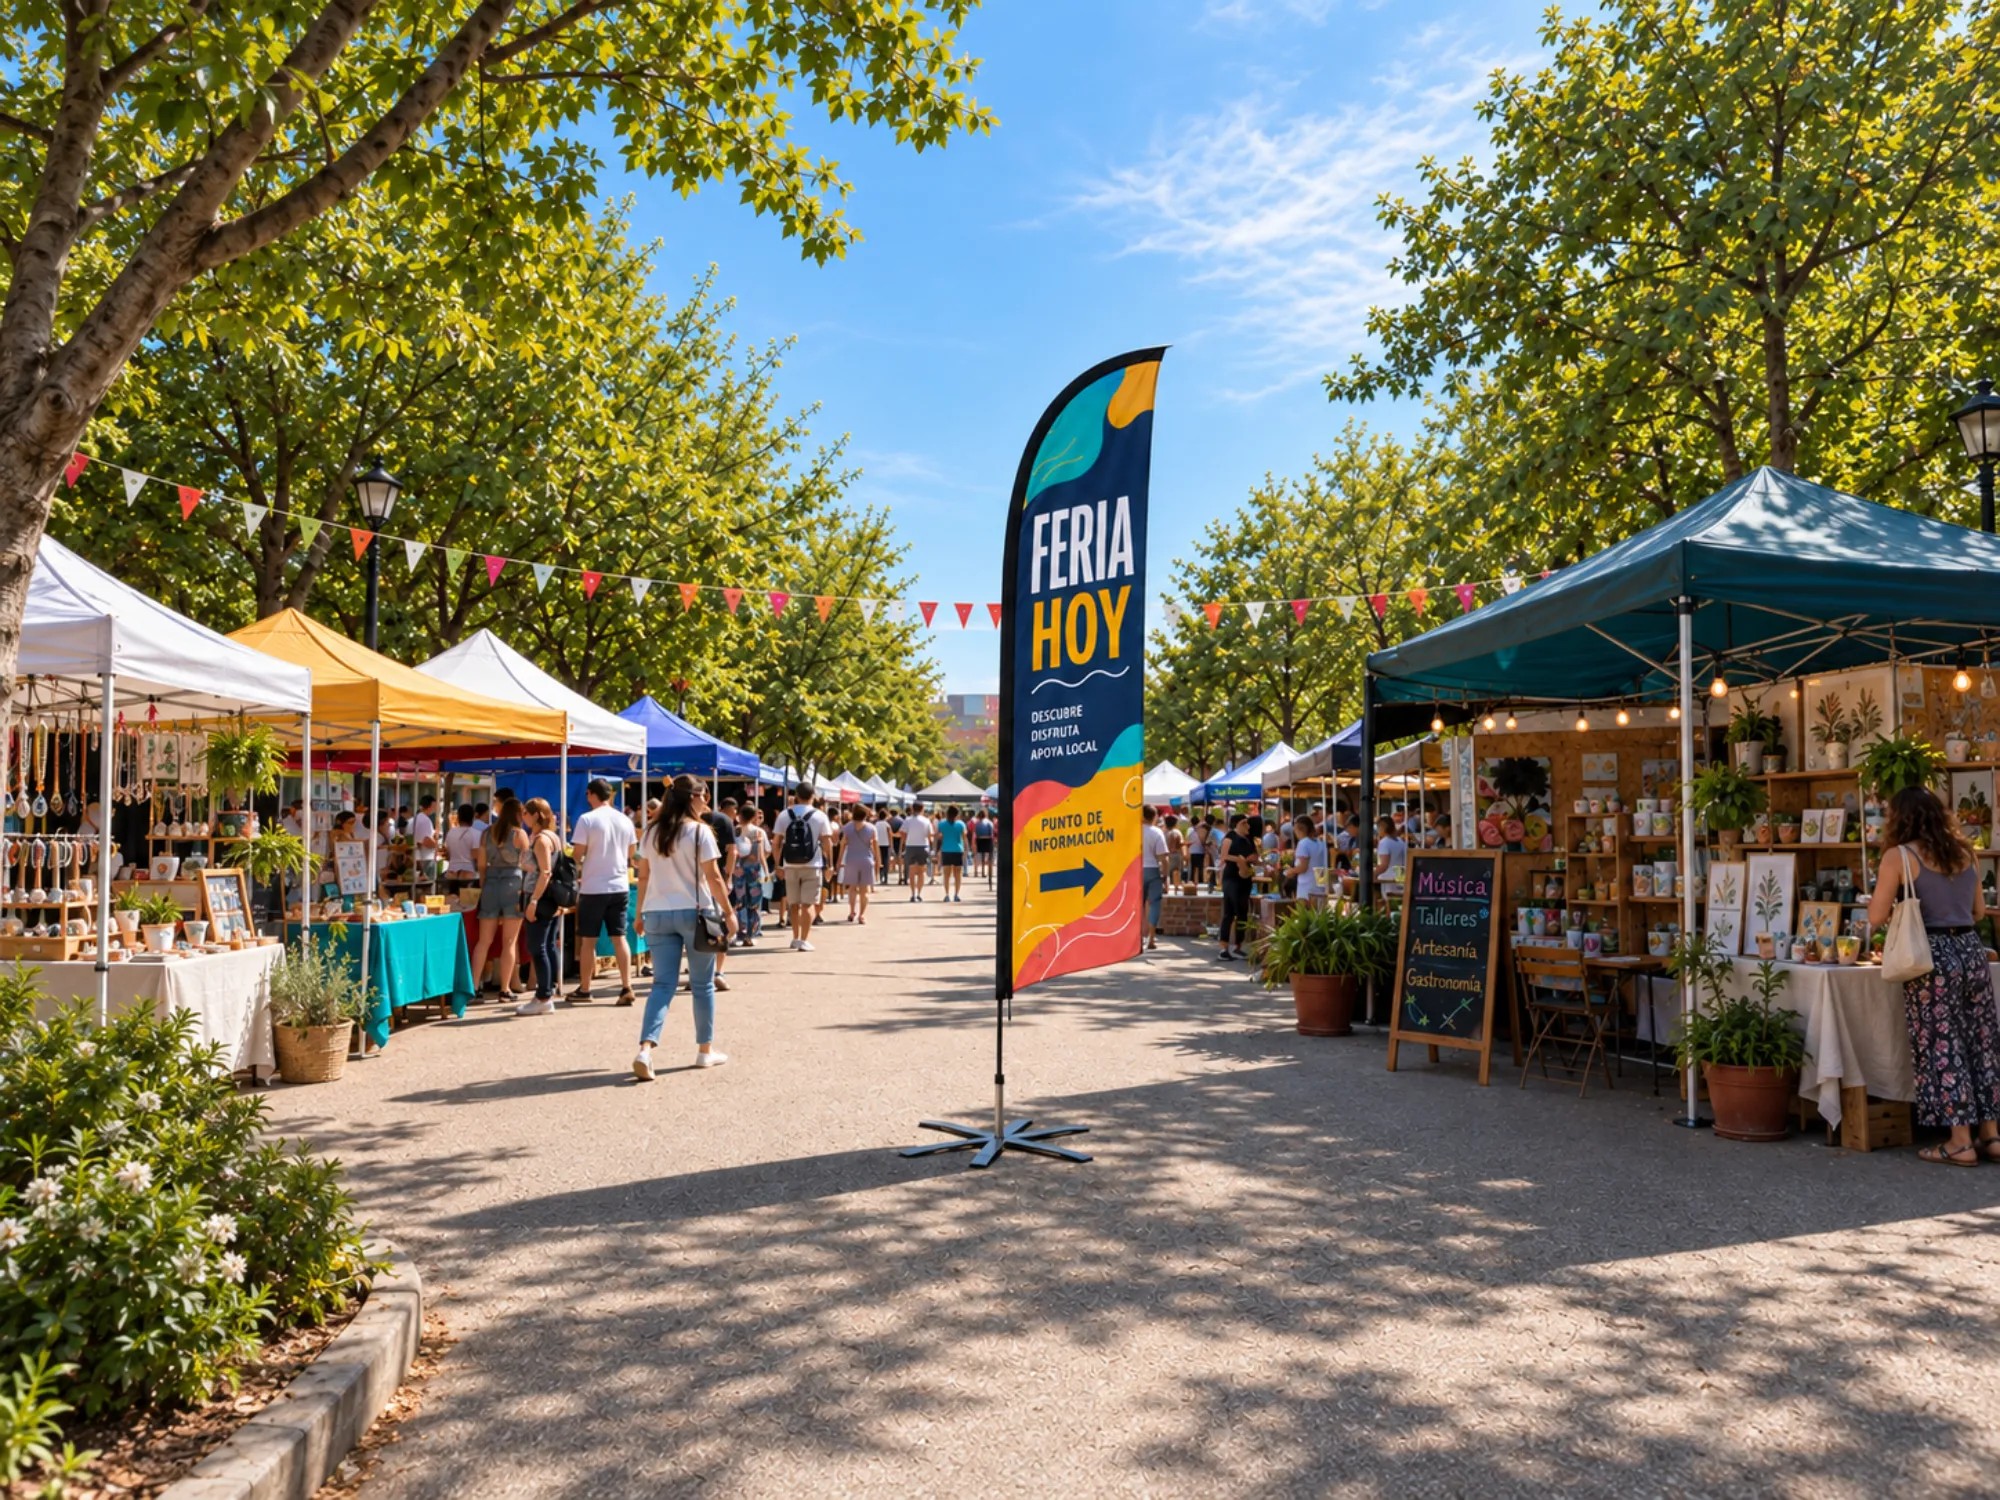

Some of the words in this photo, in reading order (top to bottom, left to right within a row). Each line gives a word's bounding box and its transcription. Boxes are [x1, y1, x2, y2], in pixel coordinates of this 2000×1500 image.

[1031, 496, 1134, 594] FERIA
[1032, 585, 1131, 672] HOY
[1031, 704, 1083, 724] DESCUBRE
[1031, 724, 1080, 742] DISFRUTA
[1030, 745, 1064, 761] APOYA
[1066, 739, 1098, 755] LOCAL
[1041, 813, 1082, 832] PUNTO
[1087, 810, 1102, 826] DE
[1029, 827, 1115, 853] INFORMACIÓN
[1418, 872, 1488, 895] Música
[1416, 906, 1477, 927] Talleres
[1411, 938, 1478, 959] Artesanía
[1406, 967, 1482, 992] Gastronomía
